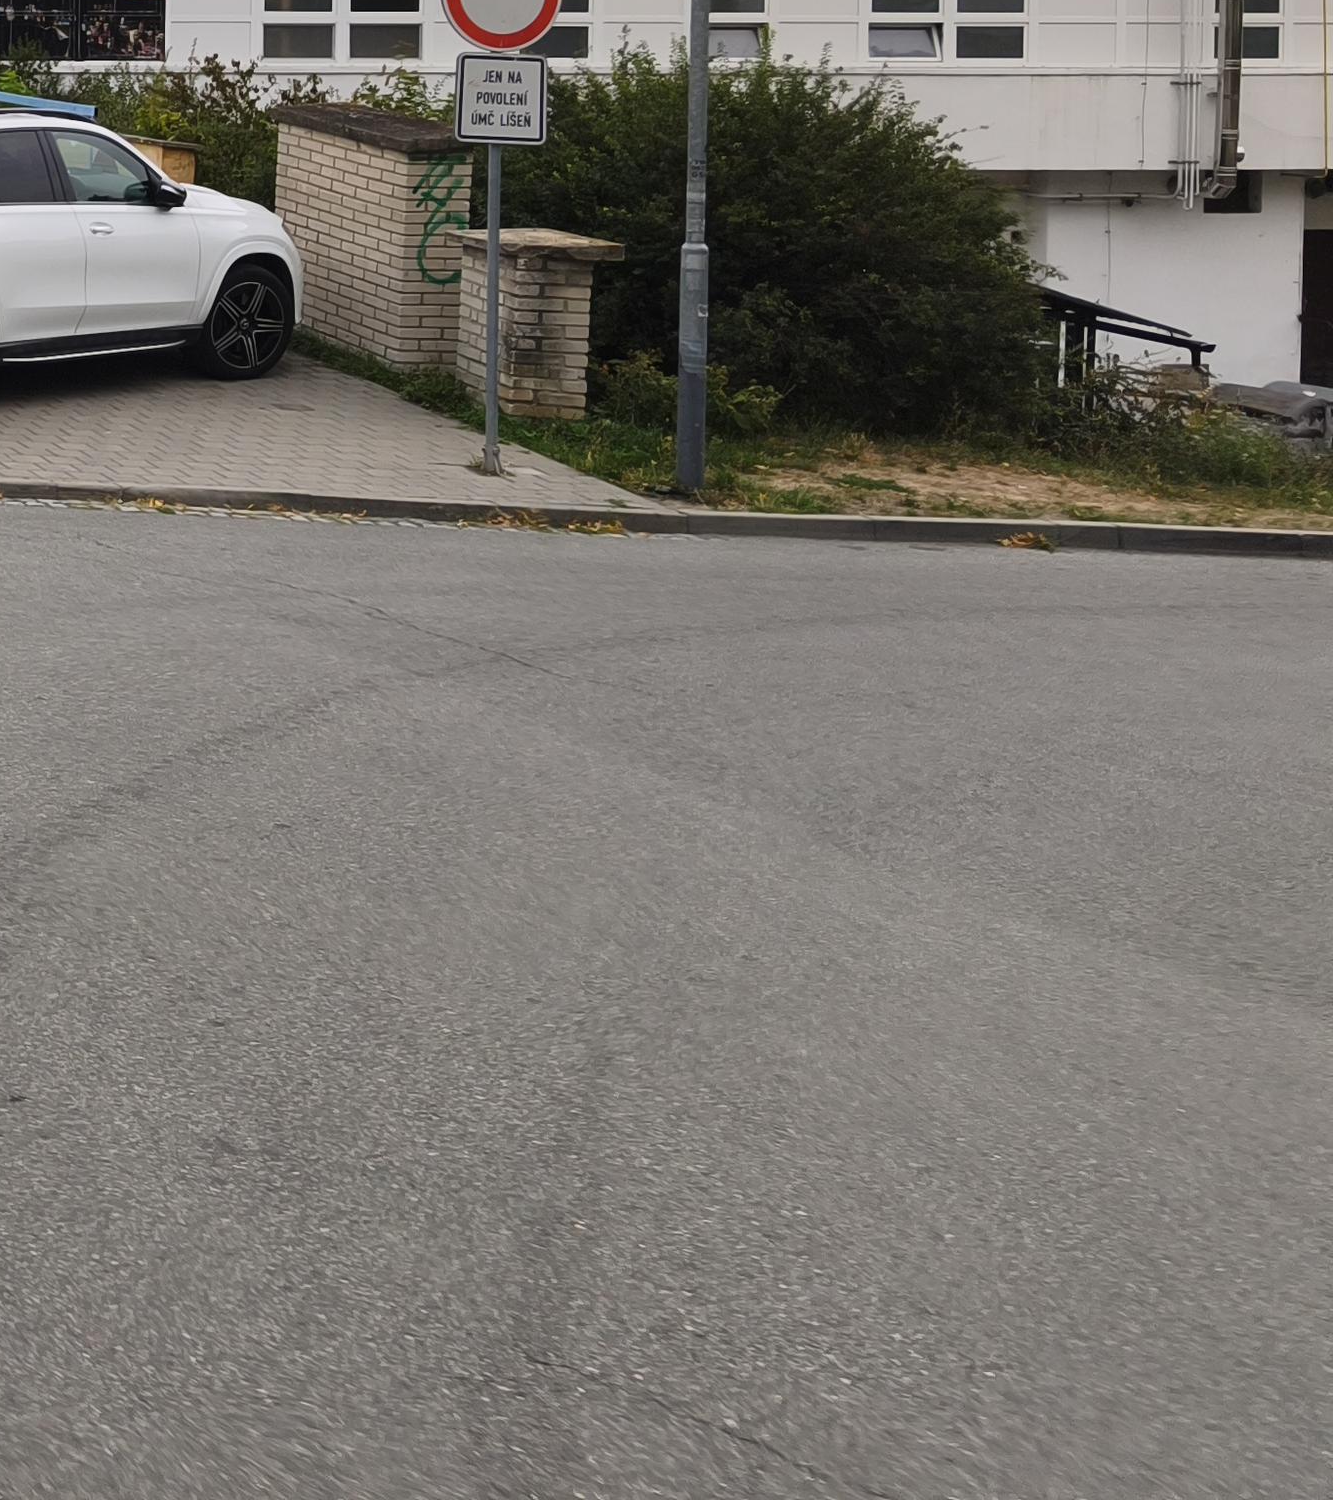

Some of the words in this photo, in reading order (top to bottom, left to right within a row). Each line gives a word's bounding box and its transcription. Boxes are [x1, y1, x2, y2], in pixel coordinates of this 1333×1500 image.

[482, 70, 502, 83] JEN
[507, 71, 522, 84] NA
[476, 90, 529, 106] POVOLENÍ
[471, 109, 495, 126] ÚMČ
[500, 110, 531, 128] LÍŠEŇ
